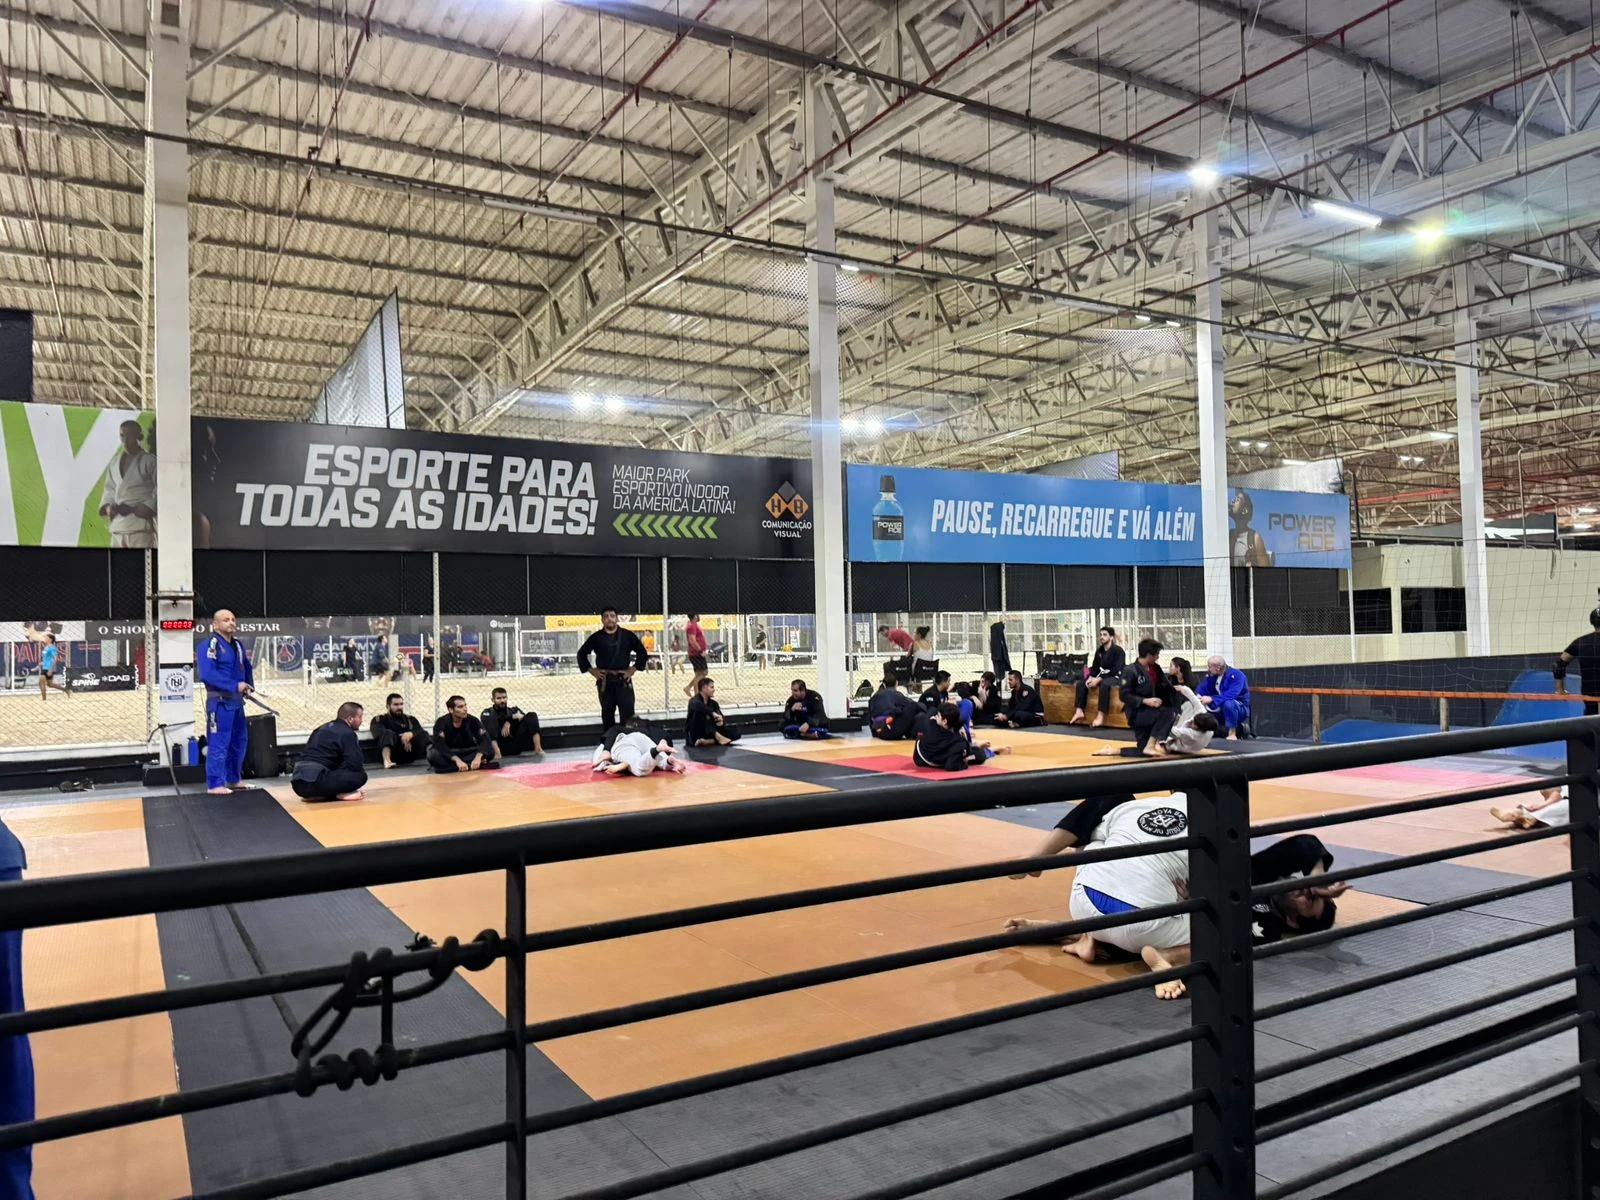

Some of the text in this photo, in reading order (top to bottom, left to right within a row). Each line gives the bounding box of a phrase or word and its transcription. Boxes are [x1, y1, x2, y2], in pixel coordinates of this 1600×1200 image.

[304, 443, 596, 498] ESPORTE PARA
[612, 464, 690, 483] MAIOR PARK
[612, 479, 729, 500] ESPORTIVO INDOOR
[235, 483, 599, 535] TODAS AS IDADES!
[613, 494, 631, 510] DA
[692, 499, 736, 515] LATINA!
[762, 519, 812, 530] COMUNICAÇÃO
[877, 521, 902, 529] POWER
[930, 499, 1196, 542] PAUSE, RECARREGUE E VÁ ALÉM
[1268, 512, 1337, 532] POWER
[774, 530, 802, 538] VISUAL
[98, 626, 109, 635] O
